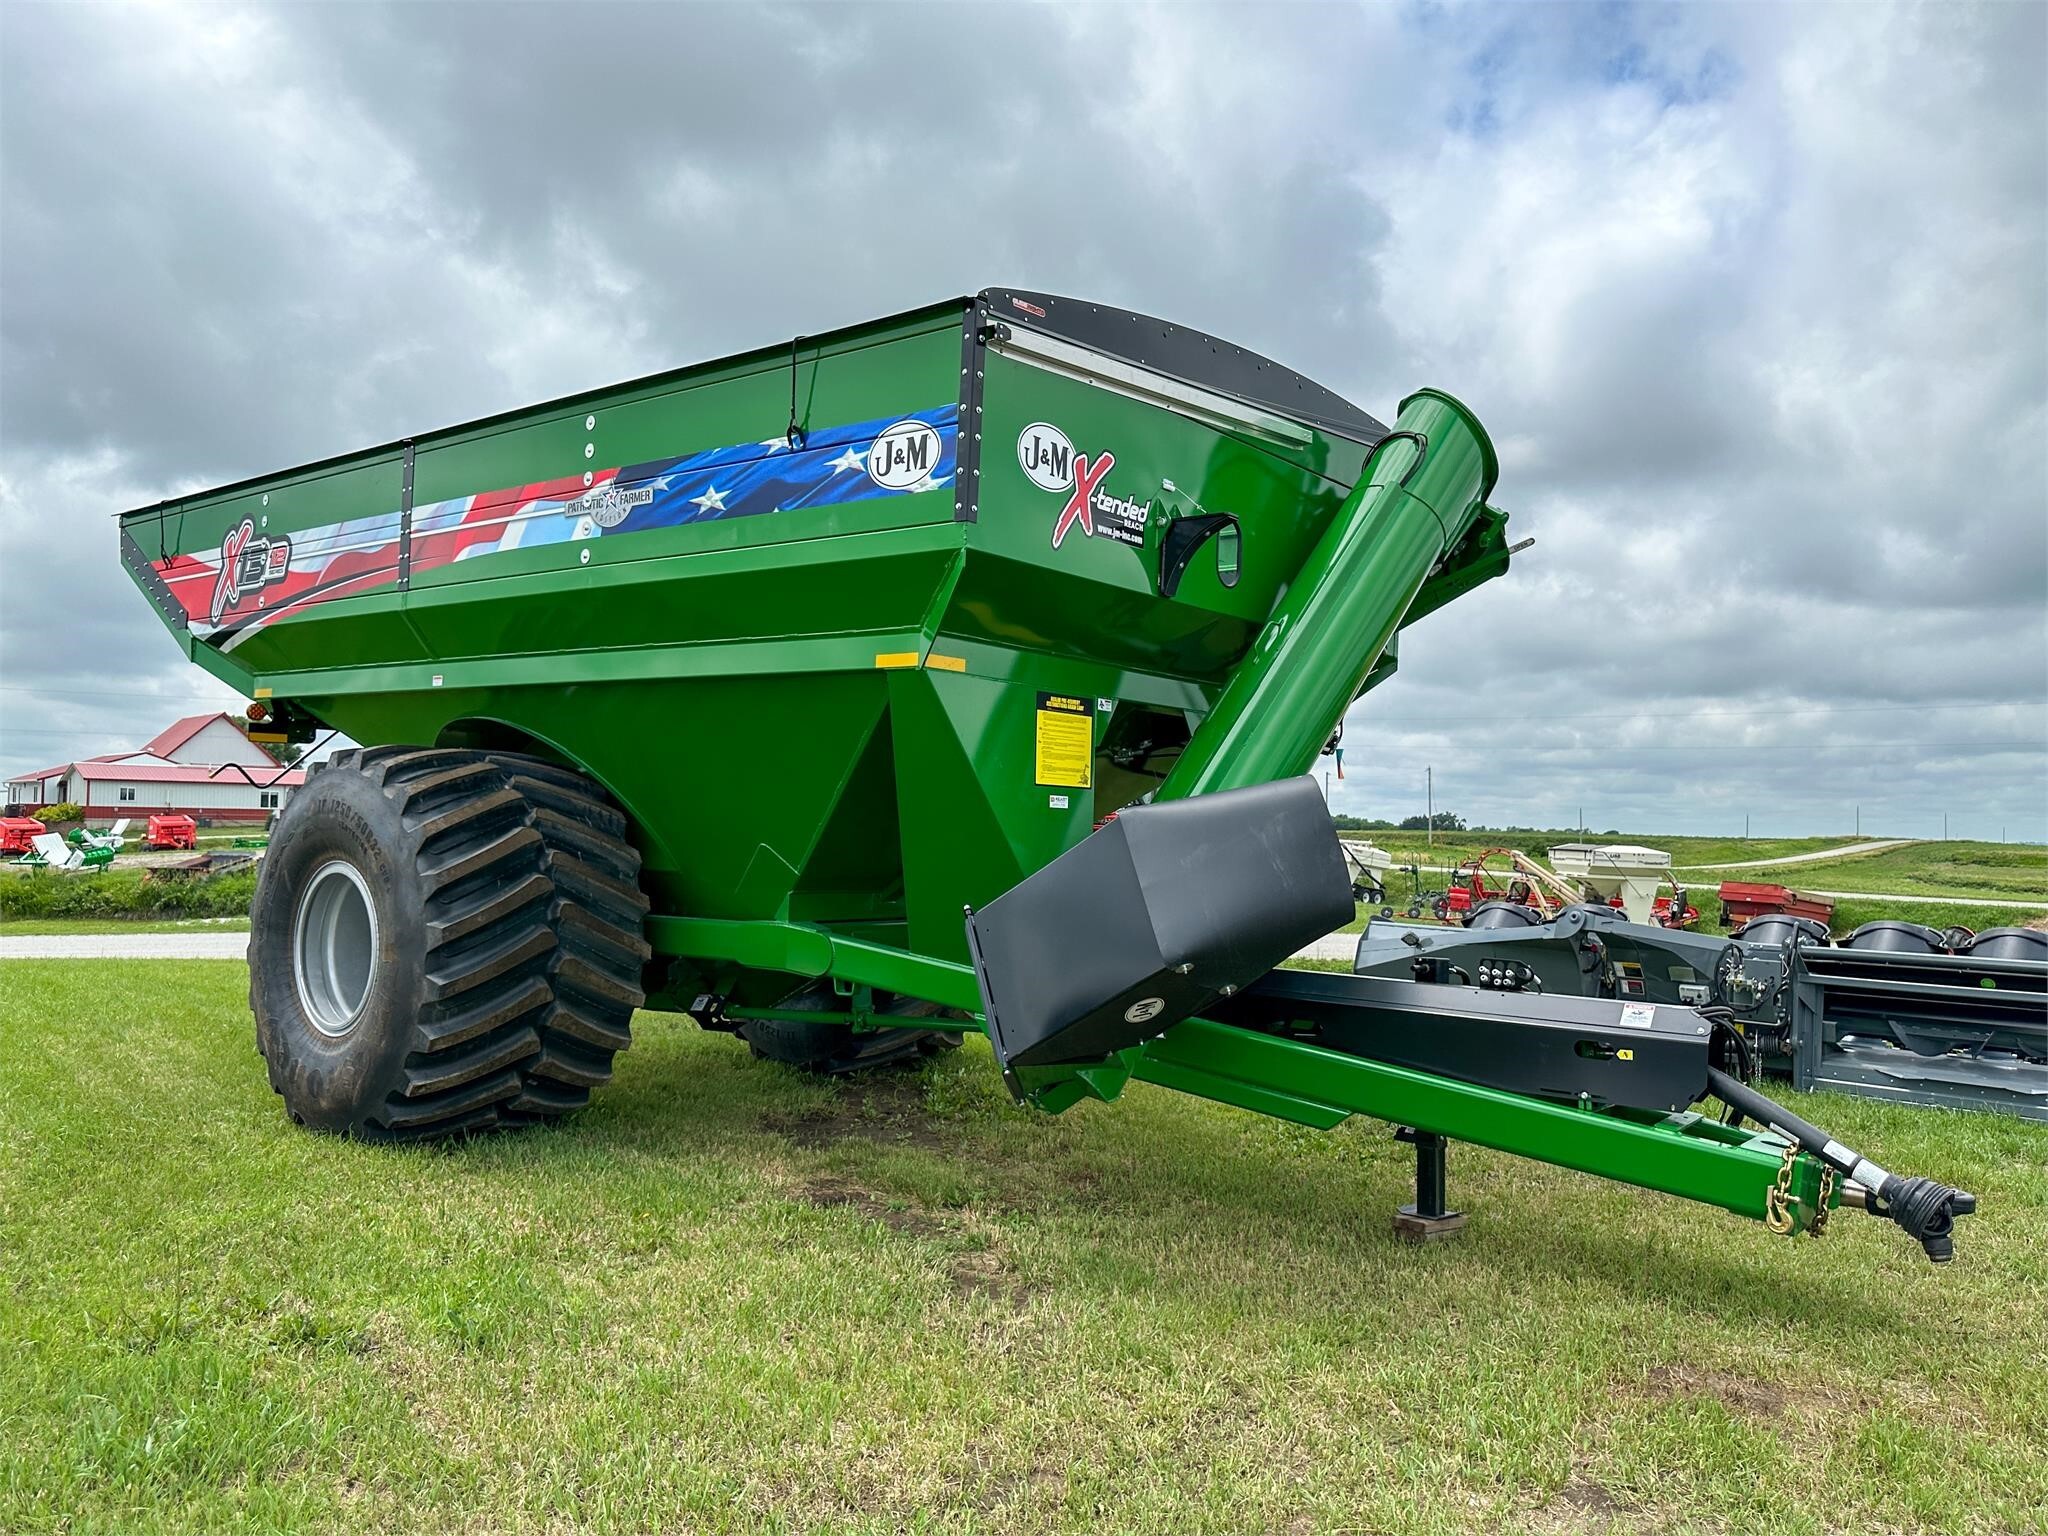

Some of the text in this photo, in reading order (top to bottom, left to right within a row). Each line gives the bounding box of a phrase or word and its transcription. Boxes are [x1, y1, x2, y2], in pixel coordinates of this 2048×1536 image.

[875, 434, 929, 476] J&M
[1024, 435, 1069, 481] J&M
[567, 490, 650, 513] PATRTIC FARMER
[1123, 520, 1144, 532] REACH
